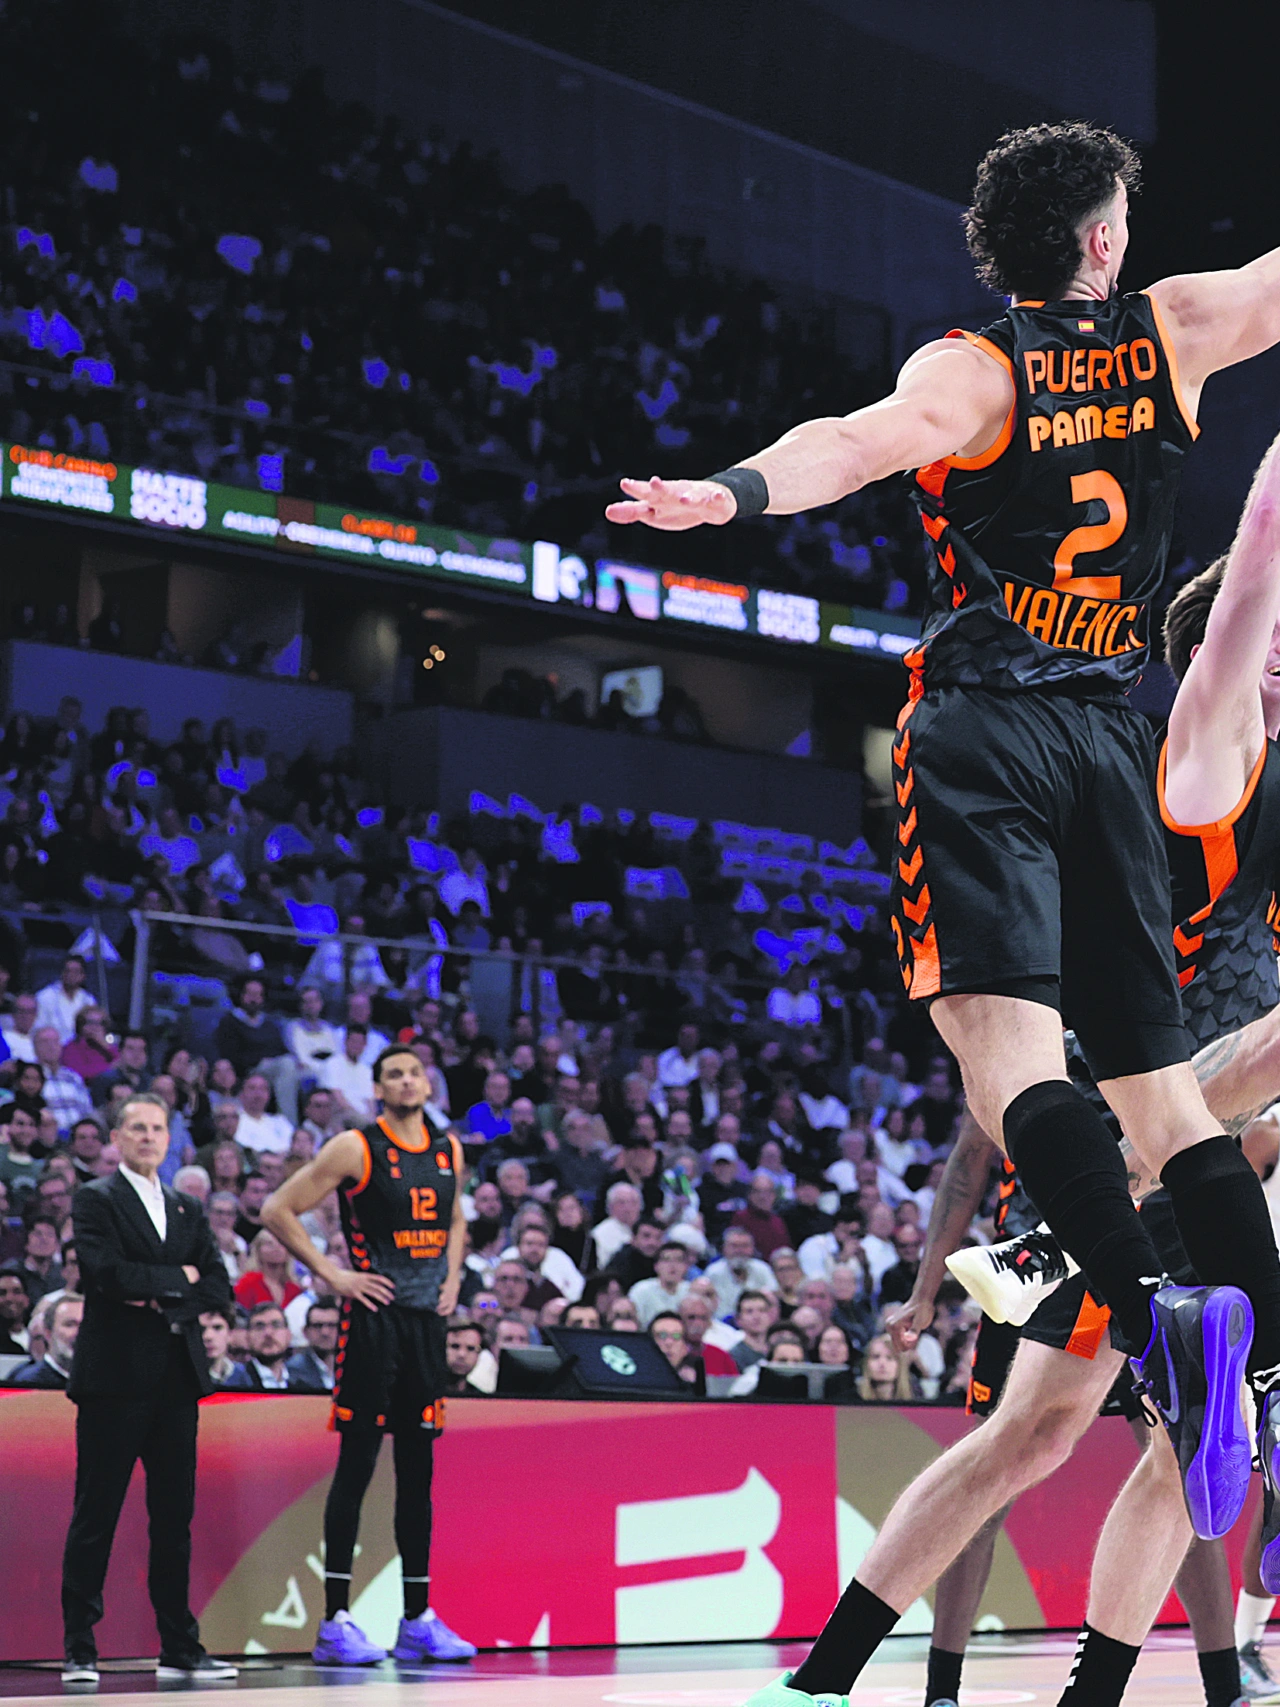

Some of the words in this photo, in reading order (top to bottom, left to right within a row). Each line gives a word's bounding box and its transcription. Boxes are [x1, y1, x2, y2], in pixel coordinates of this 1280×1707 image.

[1023, 337, 1157, 395] PUERTO
[1027, 396, 1155, 452] PAMEA
[1052, 469, 1128, 599] 2
[1004, 581, 1145, 657] VALENC
[409, 1186, 438, 1221] 12
